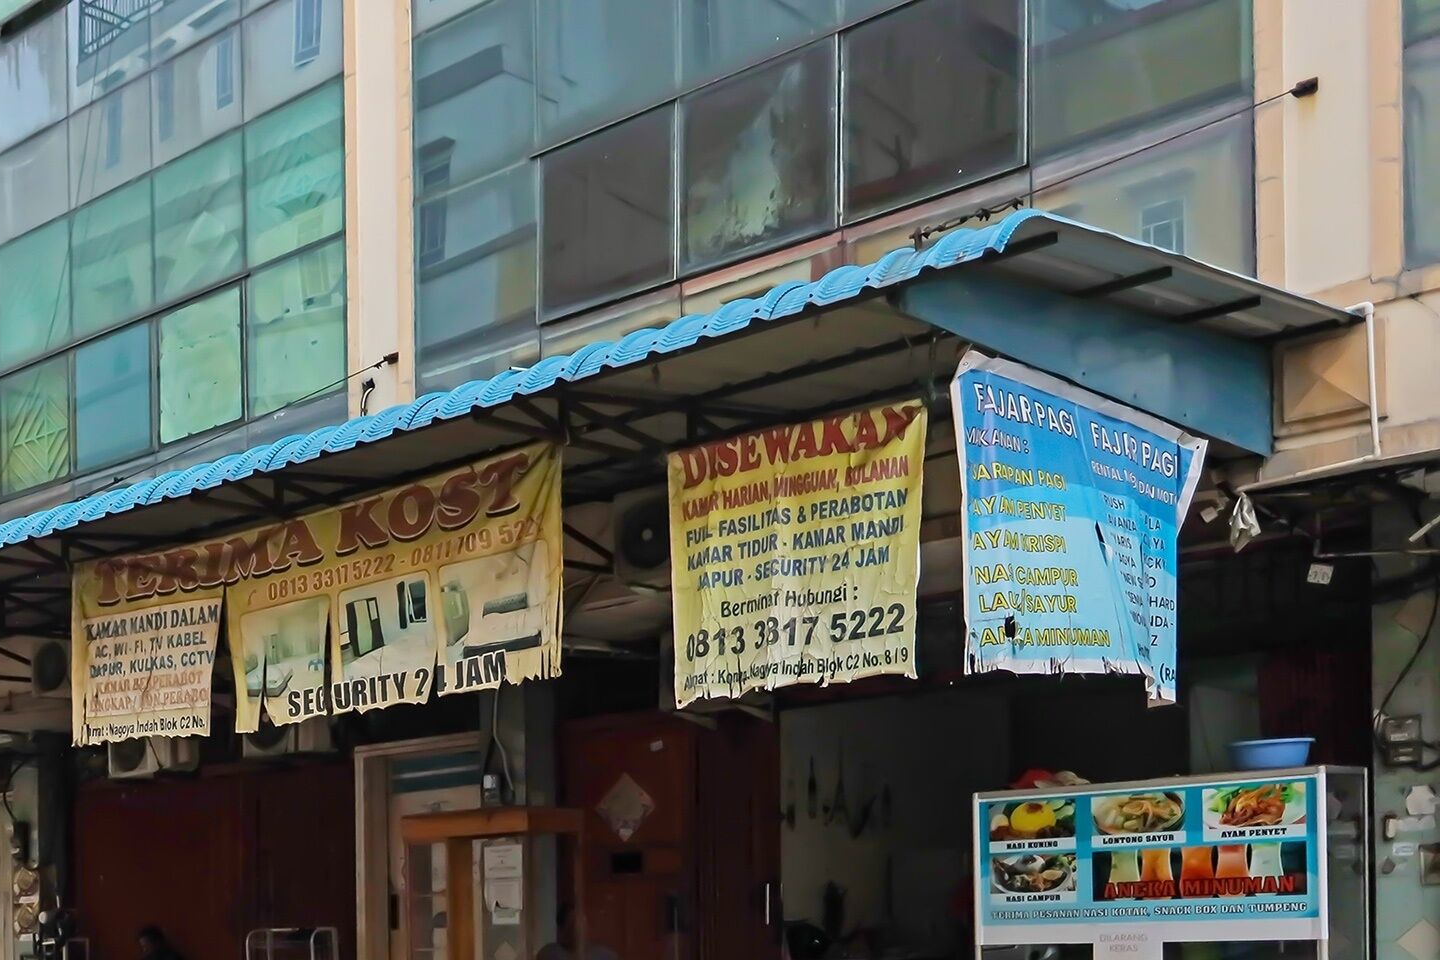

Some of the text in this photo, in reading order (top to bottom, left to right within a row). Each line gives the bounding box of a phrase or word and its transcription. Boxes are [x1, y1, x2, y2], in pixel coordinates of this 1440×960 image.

[972, 382, 1078, 439] FAJAR PAGI
[679, 405, 923, 490] DISEWAKAN
[1140, 441, 1178, 479] PAGI
[722, 480, 772, 508] HARIAN,
[844, 455, 909, 487] BULANAN
[1038, 470, 1067, 491] PAGI
[719, 507, 791, 538] FASILITAS
[797, 505, 807, 524] &
[810, 488, 910, 521] PERABOTAN
[94, 452, 530, 607] TERIMA KOST
[737, 533, 778, 560] TIDUR
[792, 525, 846, 551] KAMAR
[851, 514, 904, 541] MANDI
[268, 576, 308, 602] 0813
[312, 565, 350, 594] 3317
[352, 553, 396, 581] 5222
[755, 556, 827, 582] SECURITY
[831, 552, 850, 572] 24
[855, 546, 890, 568] JAM
[1015, 566, 1079, 587] CAMPUR
[720, 590, 780, 618] Berminat
[785, 583, 847, 608] Hubungi
[85, 617, 127, 642] KAMAR
[170, 603, 219, 628] DALAM
[686, 602, 906, 662] 0813 3317 5222
[1035, 628, 1111, 648] MINUMAN
[95, 645, 112, 660] AC,
[167, 631, 207, 650] KABEL
[129, 654, 177, 673] KULKAS,
[181, 649, 216, 666] CCTV
[781, 657, 814, 677] Indah
[846, 652, 860, 673] C2
[862, 649, 882, 668] No.
[288, 671, 408, 718] SECURITY
[454, 649, 507, 690] JAM
[109, 722, 135, 739] Nagoya
[136, 719, 158, 733] Indah
[160, 716, 178, 732] Blok
[179, 715, 191, 729] C2
[192, 714, 206, 729] No.
[1006, 840, 1059, 850] NASI KUNING
[1102, 833, 1175, 845] LONTONG SAYUR
[1221, 827, 1288, 839] AYAM PENYET
[1006, 893, 1061, 903] NASI CAMPUR
[1104, 874, 1296, 899] ANEKA MINUMAN
[991, 901, 1307, 920] TERIMA PESANAN NASI KOTAK, SNACK BOX DAN TUMPENG
